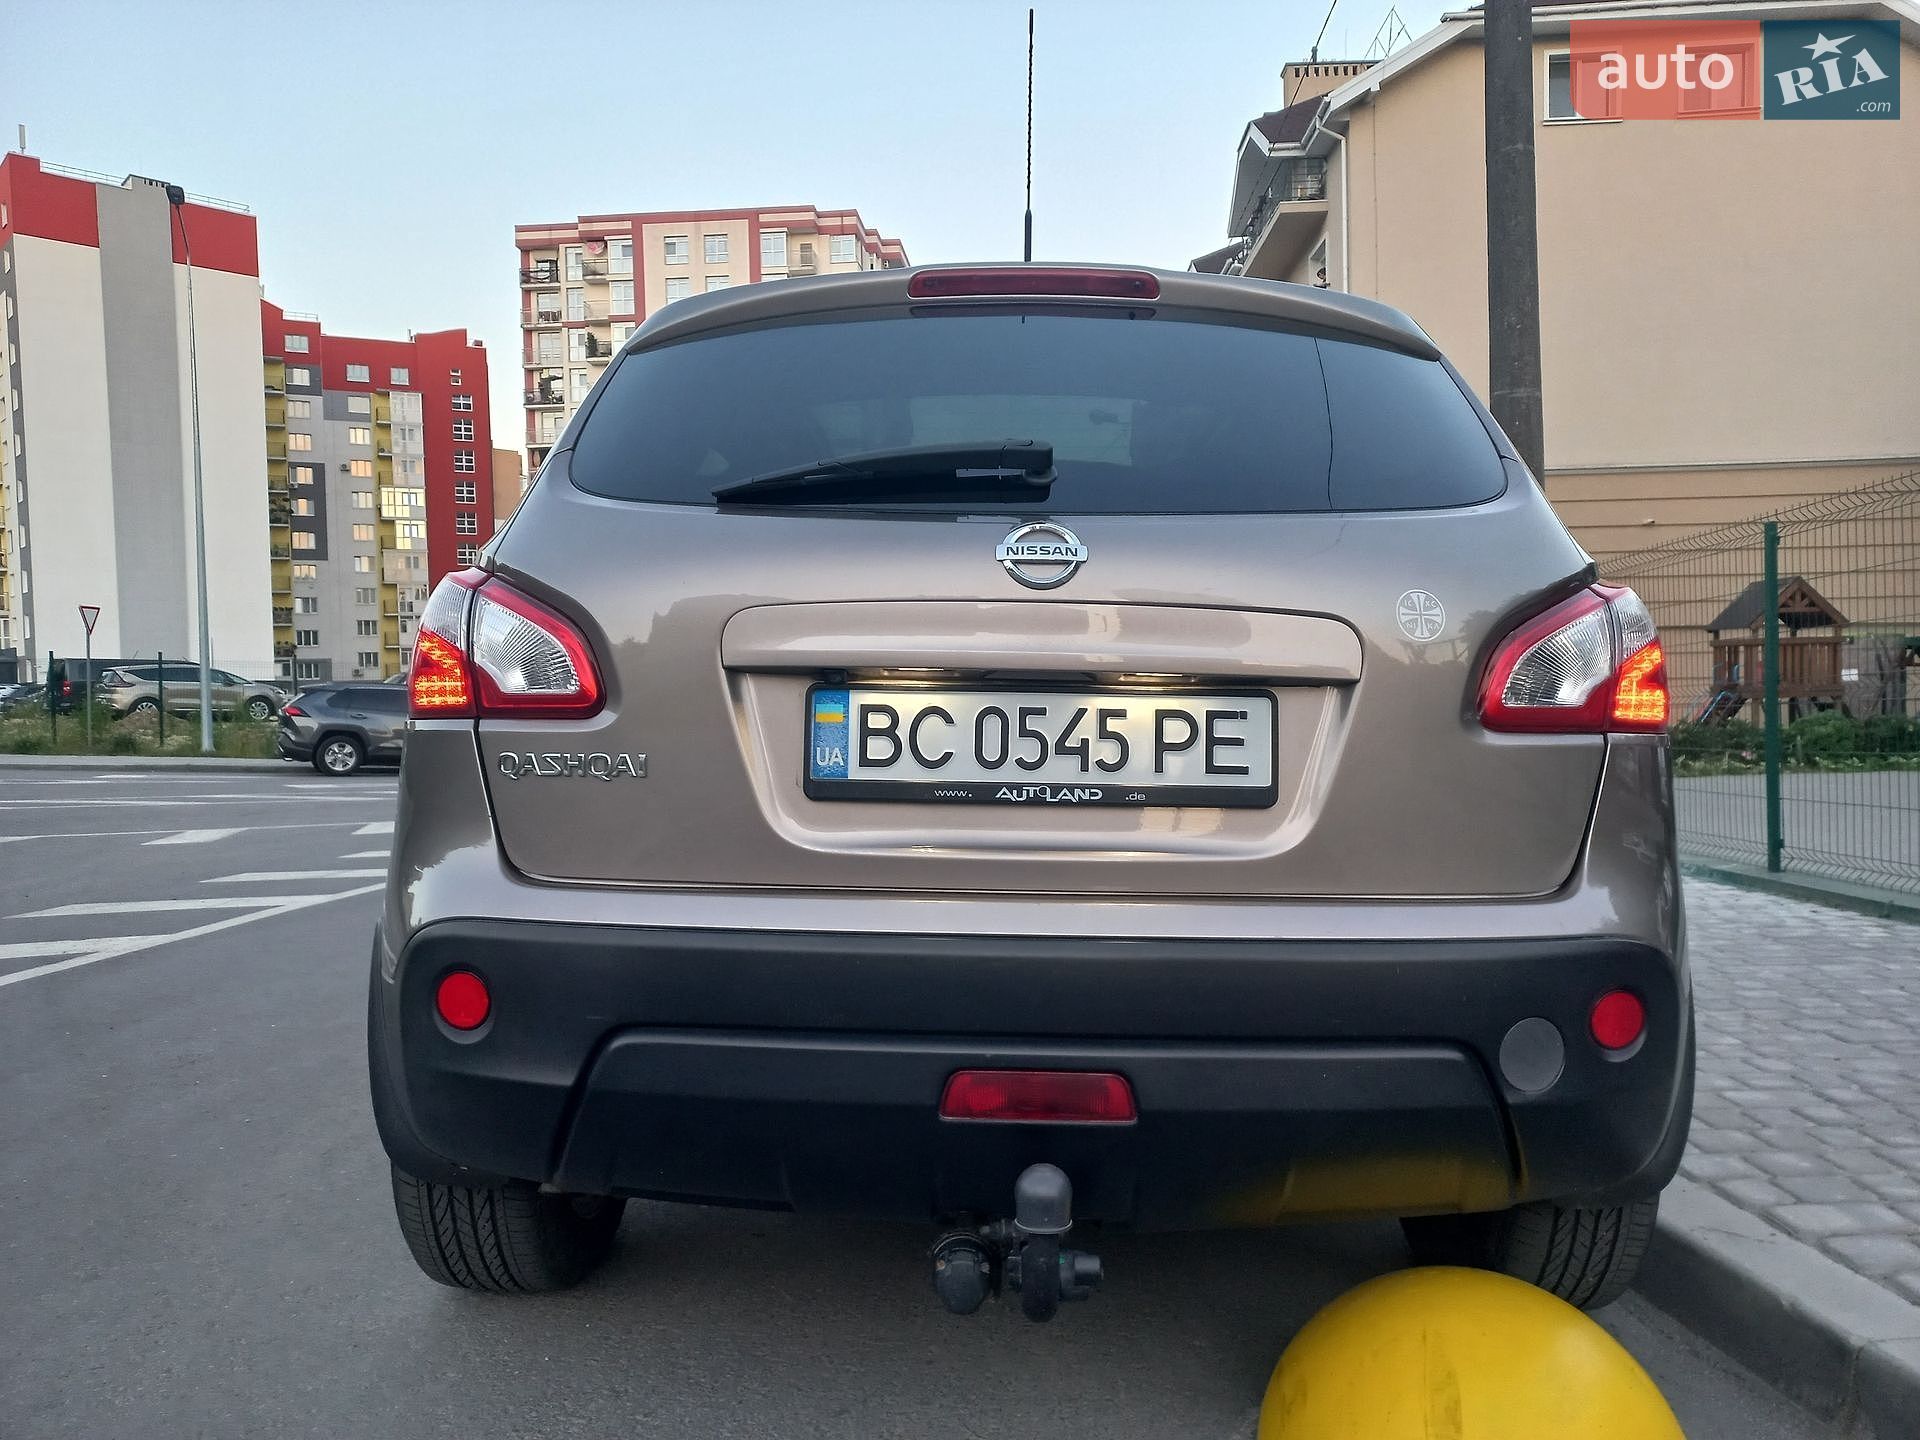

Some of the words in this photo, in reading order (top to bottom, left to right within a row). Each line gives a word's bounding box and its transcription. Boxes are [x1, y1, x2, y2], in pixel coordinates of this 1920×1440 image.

[1006, 545, 1078, 557] NISSAN
[858, 704, 955, 770] BC
[973, 705, 1130, 773] 0545
[1154, 709, 1250, 775] PE
[816, 747, 844, 766] UA
[498, 751, 649, 782] QASHQAI
[934, 789, 972, 798] www.
[1125, 791, 1146, 801] .de
